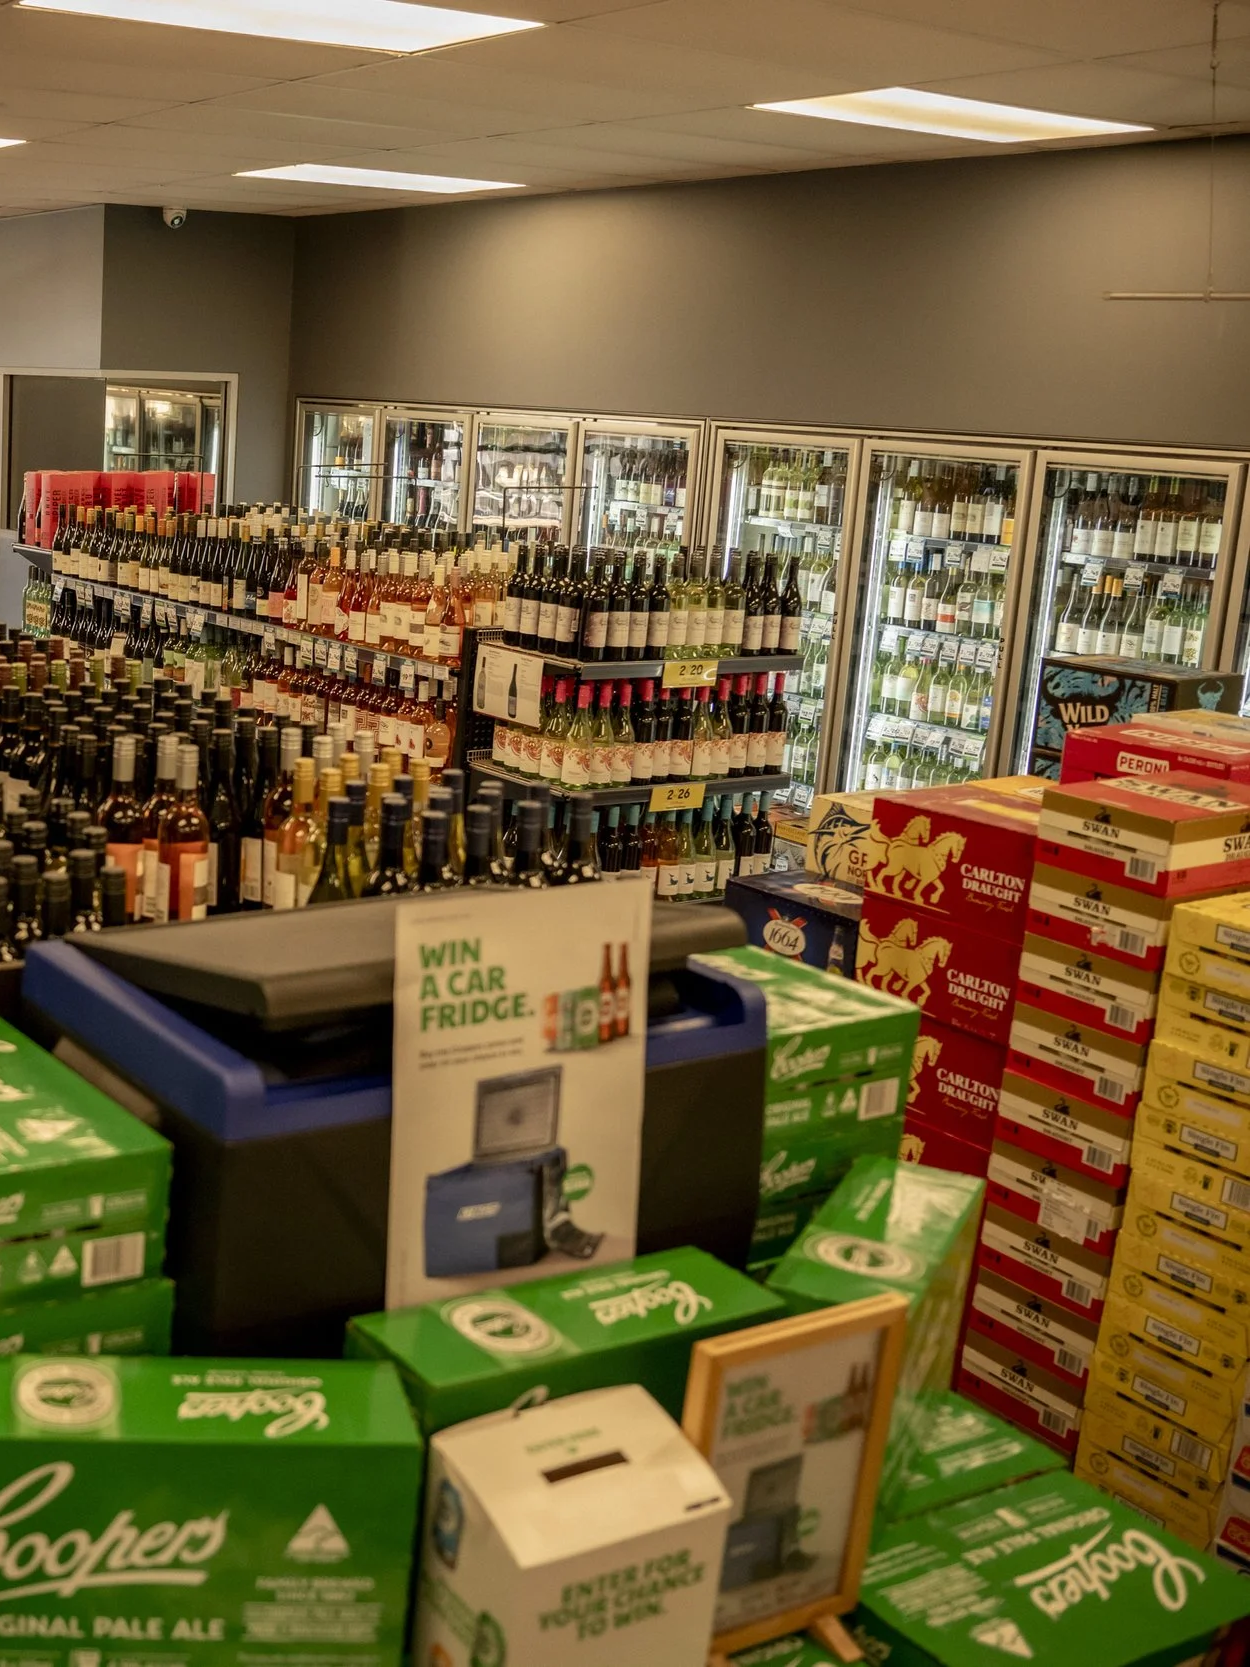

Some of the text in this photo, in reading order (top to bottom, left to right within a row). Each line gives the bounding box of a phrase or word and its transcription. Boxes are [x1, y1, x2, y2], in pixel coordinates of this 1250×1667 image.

[997, 637, 1005, 669] PULL
[679, 664, 704, 676] 2 20
[1058, 702, 1110, 724] WILD
[1119, 756, 1169, 774] PERONI
[667, 788, 690, 800] 2 26
[1082, 820, 1120, 839] SWAN
[960, 863, 1025, 891] CARLTON
[962, 878, 1022, 903] DRAUGHT
[1073, 896, 1111, 917] SWAN
[769, 926, 800, 951] 1664
[419, 938, 481, 969] WIN
[419, 966, 506, 1000] A CAR
[947, 969, 1010, 1000] CARLTON
[1065, 967, 1102, 986] SWAN
[948, 982, 1007, 1012] DRAUGHT
[1212, 995, 1238, 1010] Single
[420, 994, 534, 1033] FRIDGE.
[1053, 1037, 1090, 1057] SWAN
[936, 1068, 1000, 1100] CARLTON
[1201, 1066, 1245, 1087] Single Fin
[938, 1081, 996, 1112] DRAUGHT
[1042, 1109, 1079, 1131] SWAN
[1187, 1129, 1231, 1152] Single Fin
[1178, 1198, 1220, 1221] Single Fin
[1023, 1241, 1059, 1265] SWAN
[1165, 1259, 1207, 1284] Single Fin
[588, 1281, 712, 1325] Coopers
[1015, 1304, 1050, 1328] SWAN
[1152, 1323, 1193, 1347] Single Fin
[1000, 1368, 1035, 1393] SWAN
[1139, 1381, 1164, 1397] Single
[177, 1388, 330, 1439] Coopers
[561, 1550, 692, 1600] ENTER FOR
[1013, 1523, 1206, 1620] Coopers
[538, 1562, 705, 1631] YOUR CHANCE
[93, 1615, 164, 1641] PALE
[171, 1617, 226, 1641] ALE
[575, 1617, 608, 1642] TO
